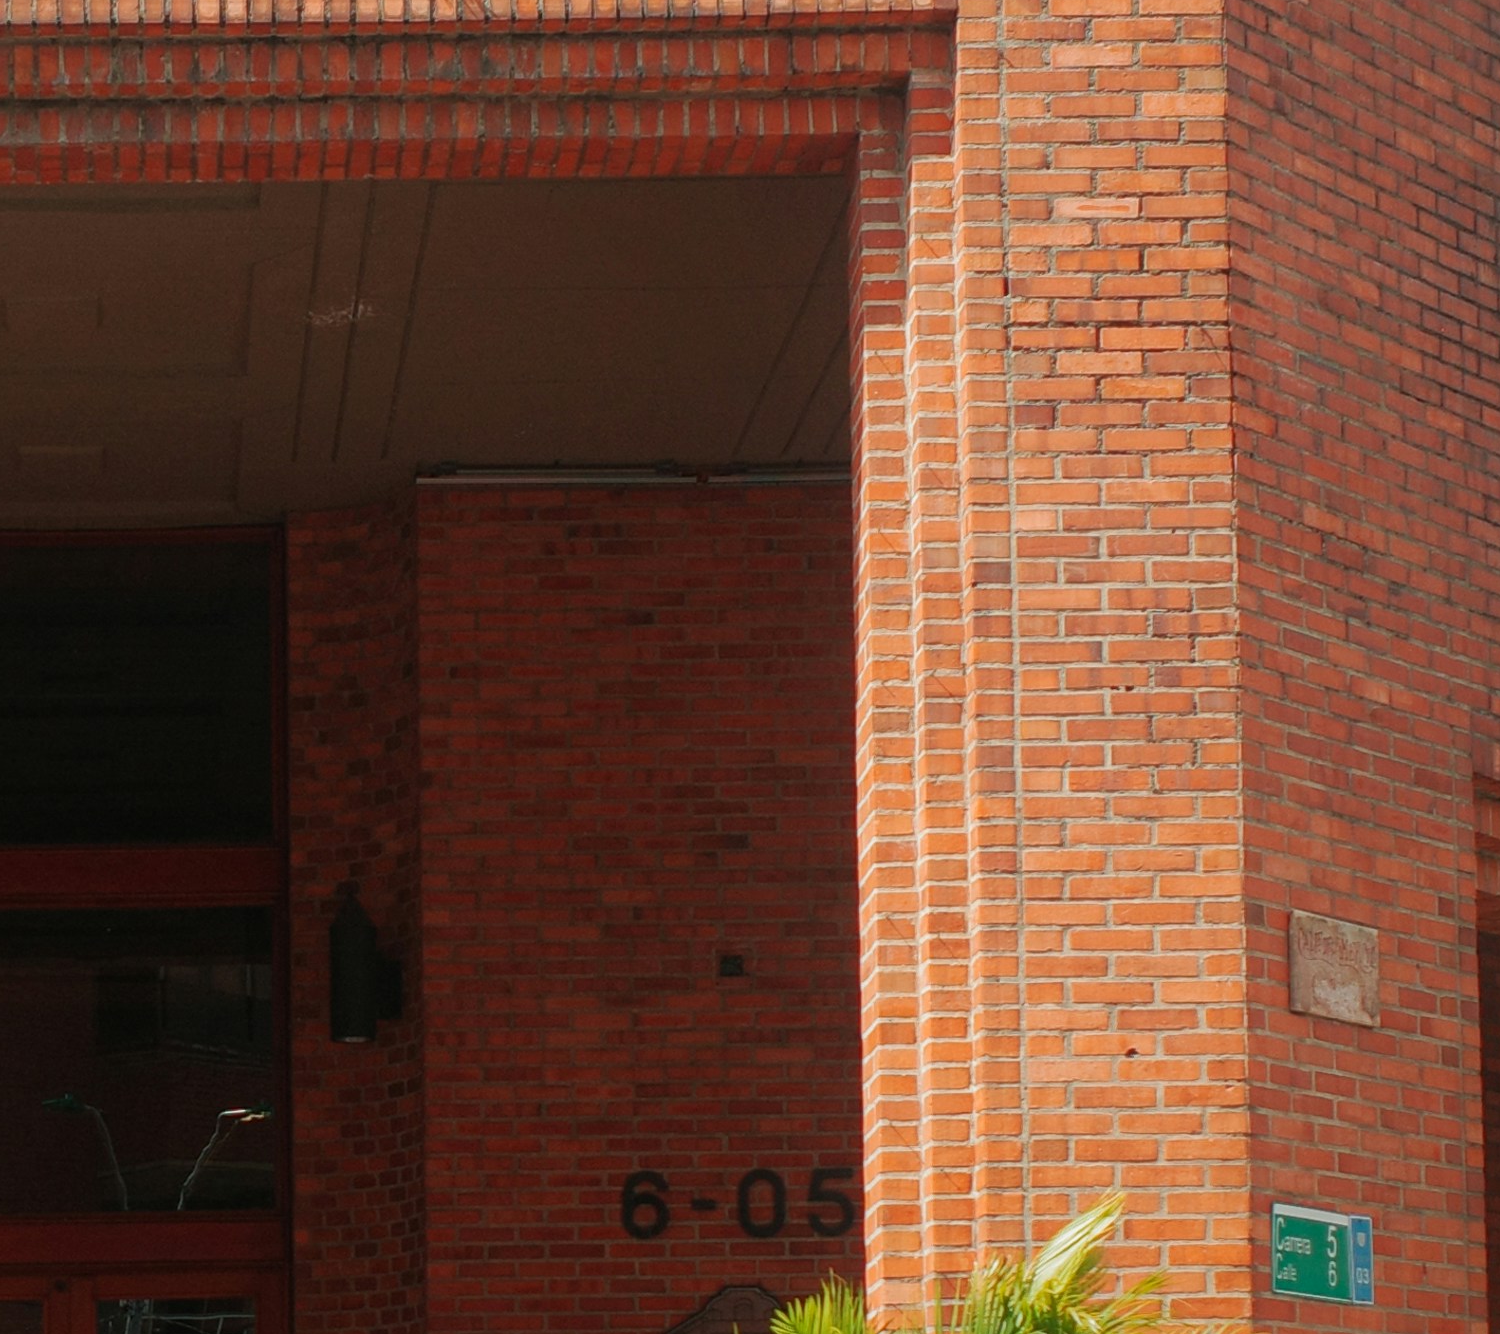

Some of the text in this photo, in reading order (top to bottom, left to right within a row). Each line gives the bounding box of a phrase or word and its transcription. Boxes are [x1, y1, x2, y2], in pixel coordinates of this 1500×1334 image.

[621, 1167, 857, 1240] 6-05
[1326, 1224, 1338, 1259] 5
[1327, 1260, 1338, 1288] 6
